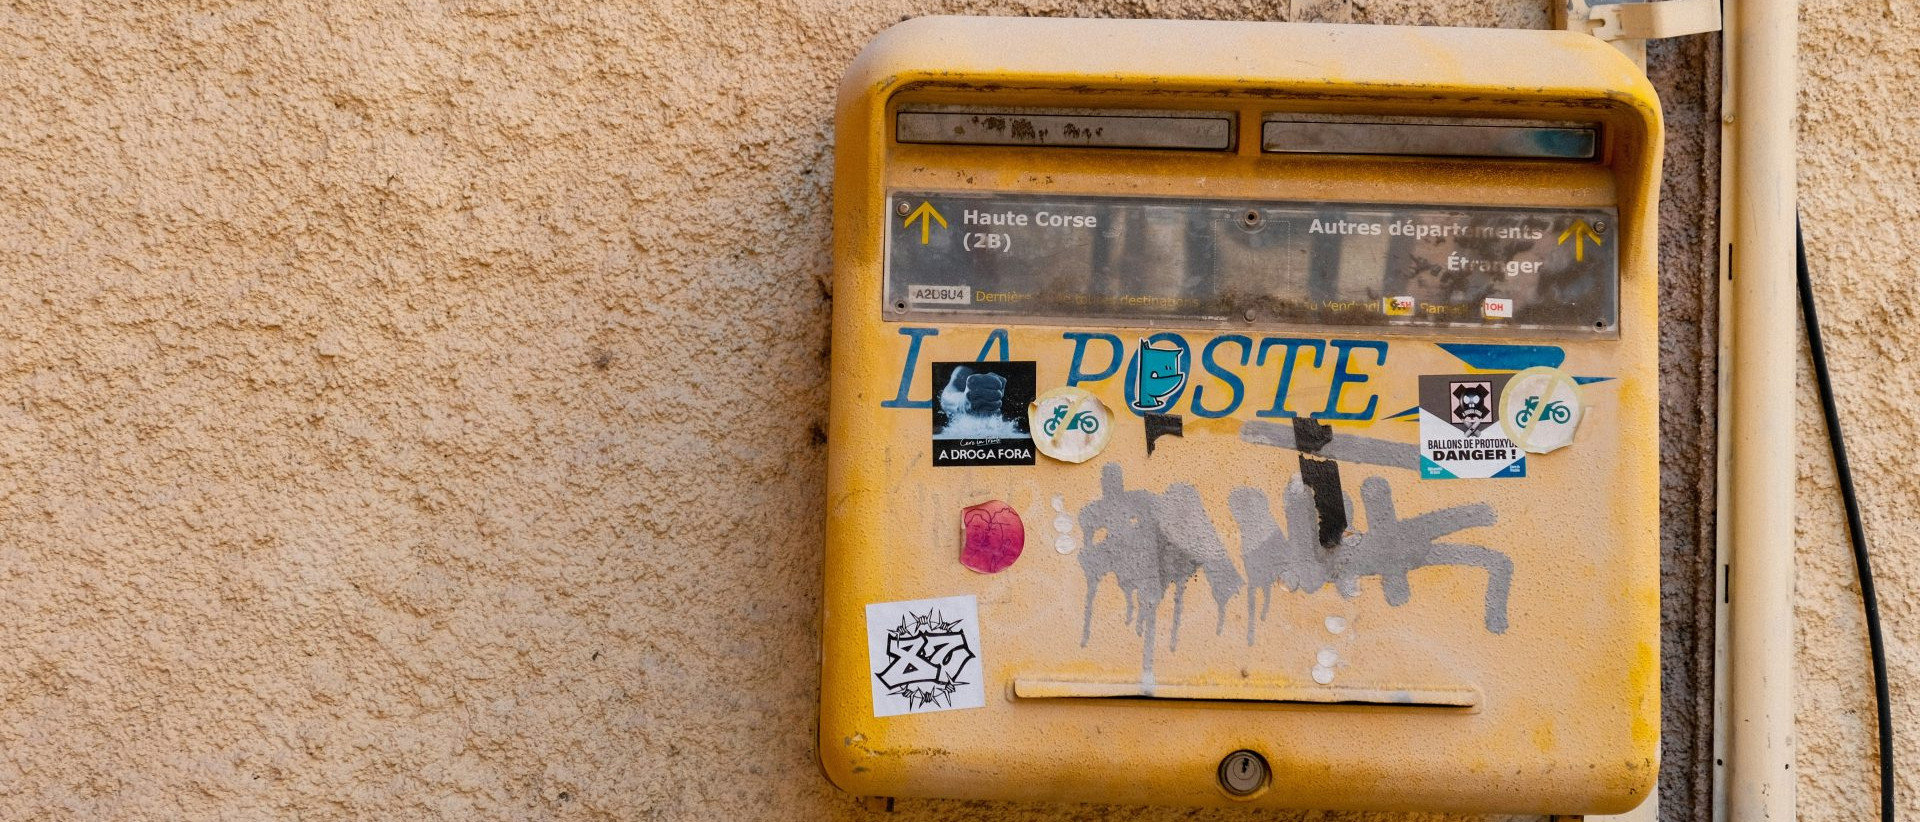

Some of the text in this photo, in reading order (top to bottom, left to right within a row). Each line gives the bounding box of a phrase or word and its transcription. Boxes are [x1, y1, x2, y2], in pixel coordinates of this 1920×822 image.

[963, 209, 1097, 228] Haute Corse
[1308, 218, 1382, 235] Autres
[963, 232, 1011, 253] (2B)
[1062, 332, 1389, 420] POSTE
[1428, 439, 1463, 450] BALLONS
[1464, 439, 1474, 449] DE
[939, 448, 1031, 460] A DROGA FORA
[1433, 449, 1507, 461] DANGER
